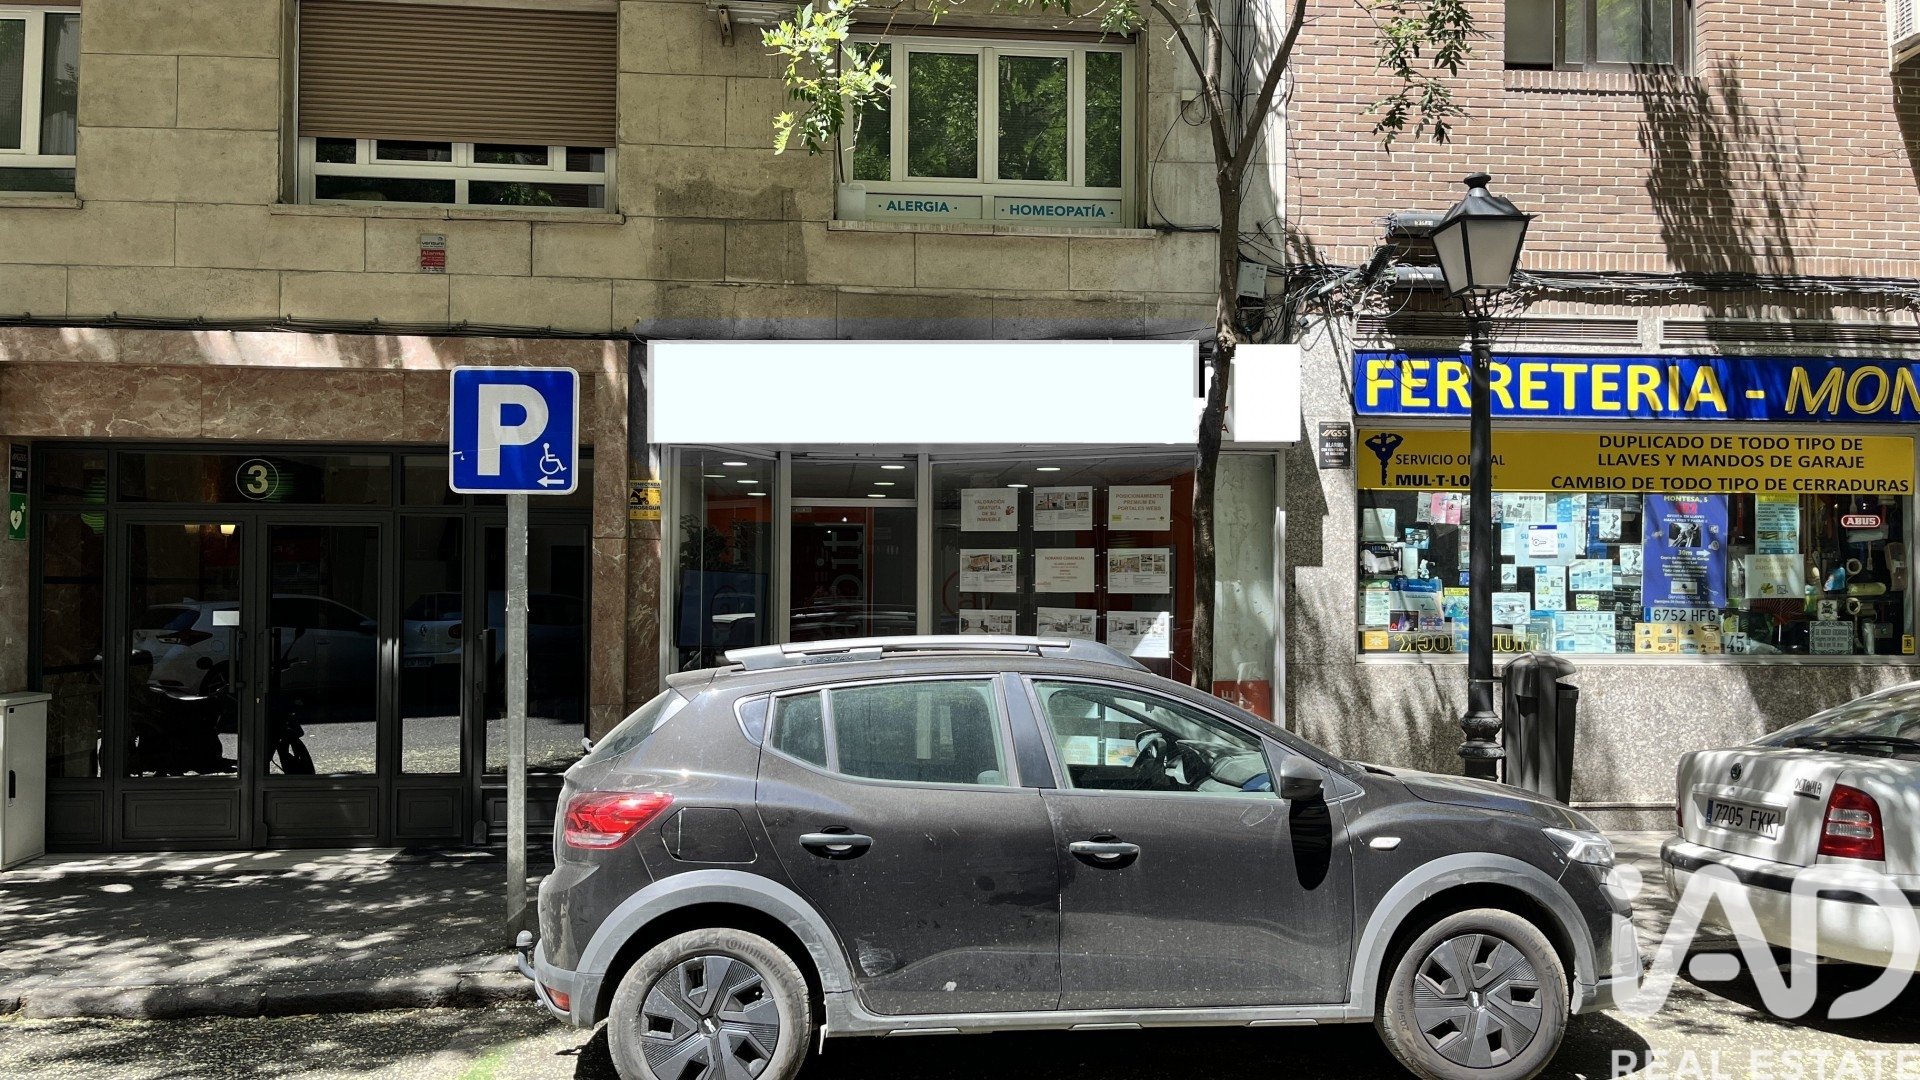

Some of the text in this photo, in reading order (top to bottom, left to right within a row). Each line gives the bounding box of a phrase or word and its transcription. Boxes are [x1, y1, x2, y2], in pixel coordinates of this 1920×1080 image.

[886, 200, 950, 213] ALERGIA
[1009, 203, 1106, 218] HOMEOPATÍA
[1366, 359, 1728, 412] FERRETERIA
[477, 384, 549, 476] P
[1600, 435, 1863, 451] DUPLICADO DE TODO TIPO DE
[1395, 454, 1453, 466] SERVICIO
[1598, 453, 1864, 469] LLAVES Y MANDOS DE GARAJE
[247, 465, 268, 494] 3
[1396, 474, 1492, 487] MUL-T-LO
[1551, 476, 1909, 492] CAMBIO DE TODO TIPO DE CERRADURAS
[1846, 517, 1876, 525] ABUS
[1653, 609, 1716, 622] 6752 HFG
[1727, 635, 1744, 652] 45
[1714, 803, 1776, 834] 7705 FKK
